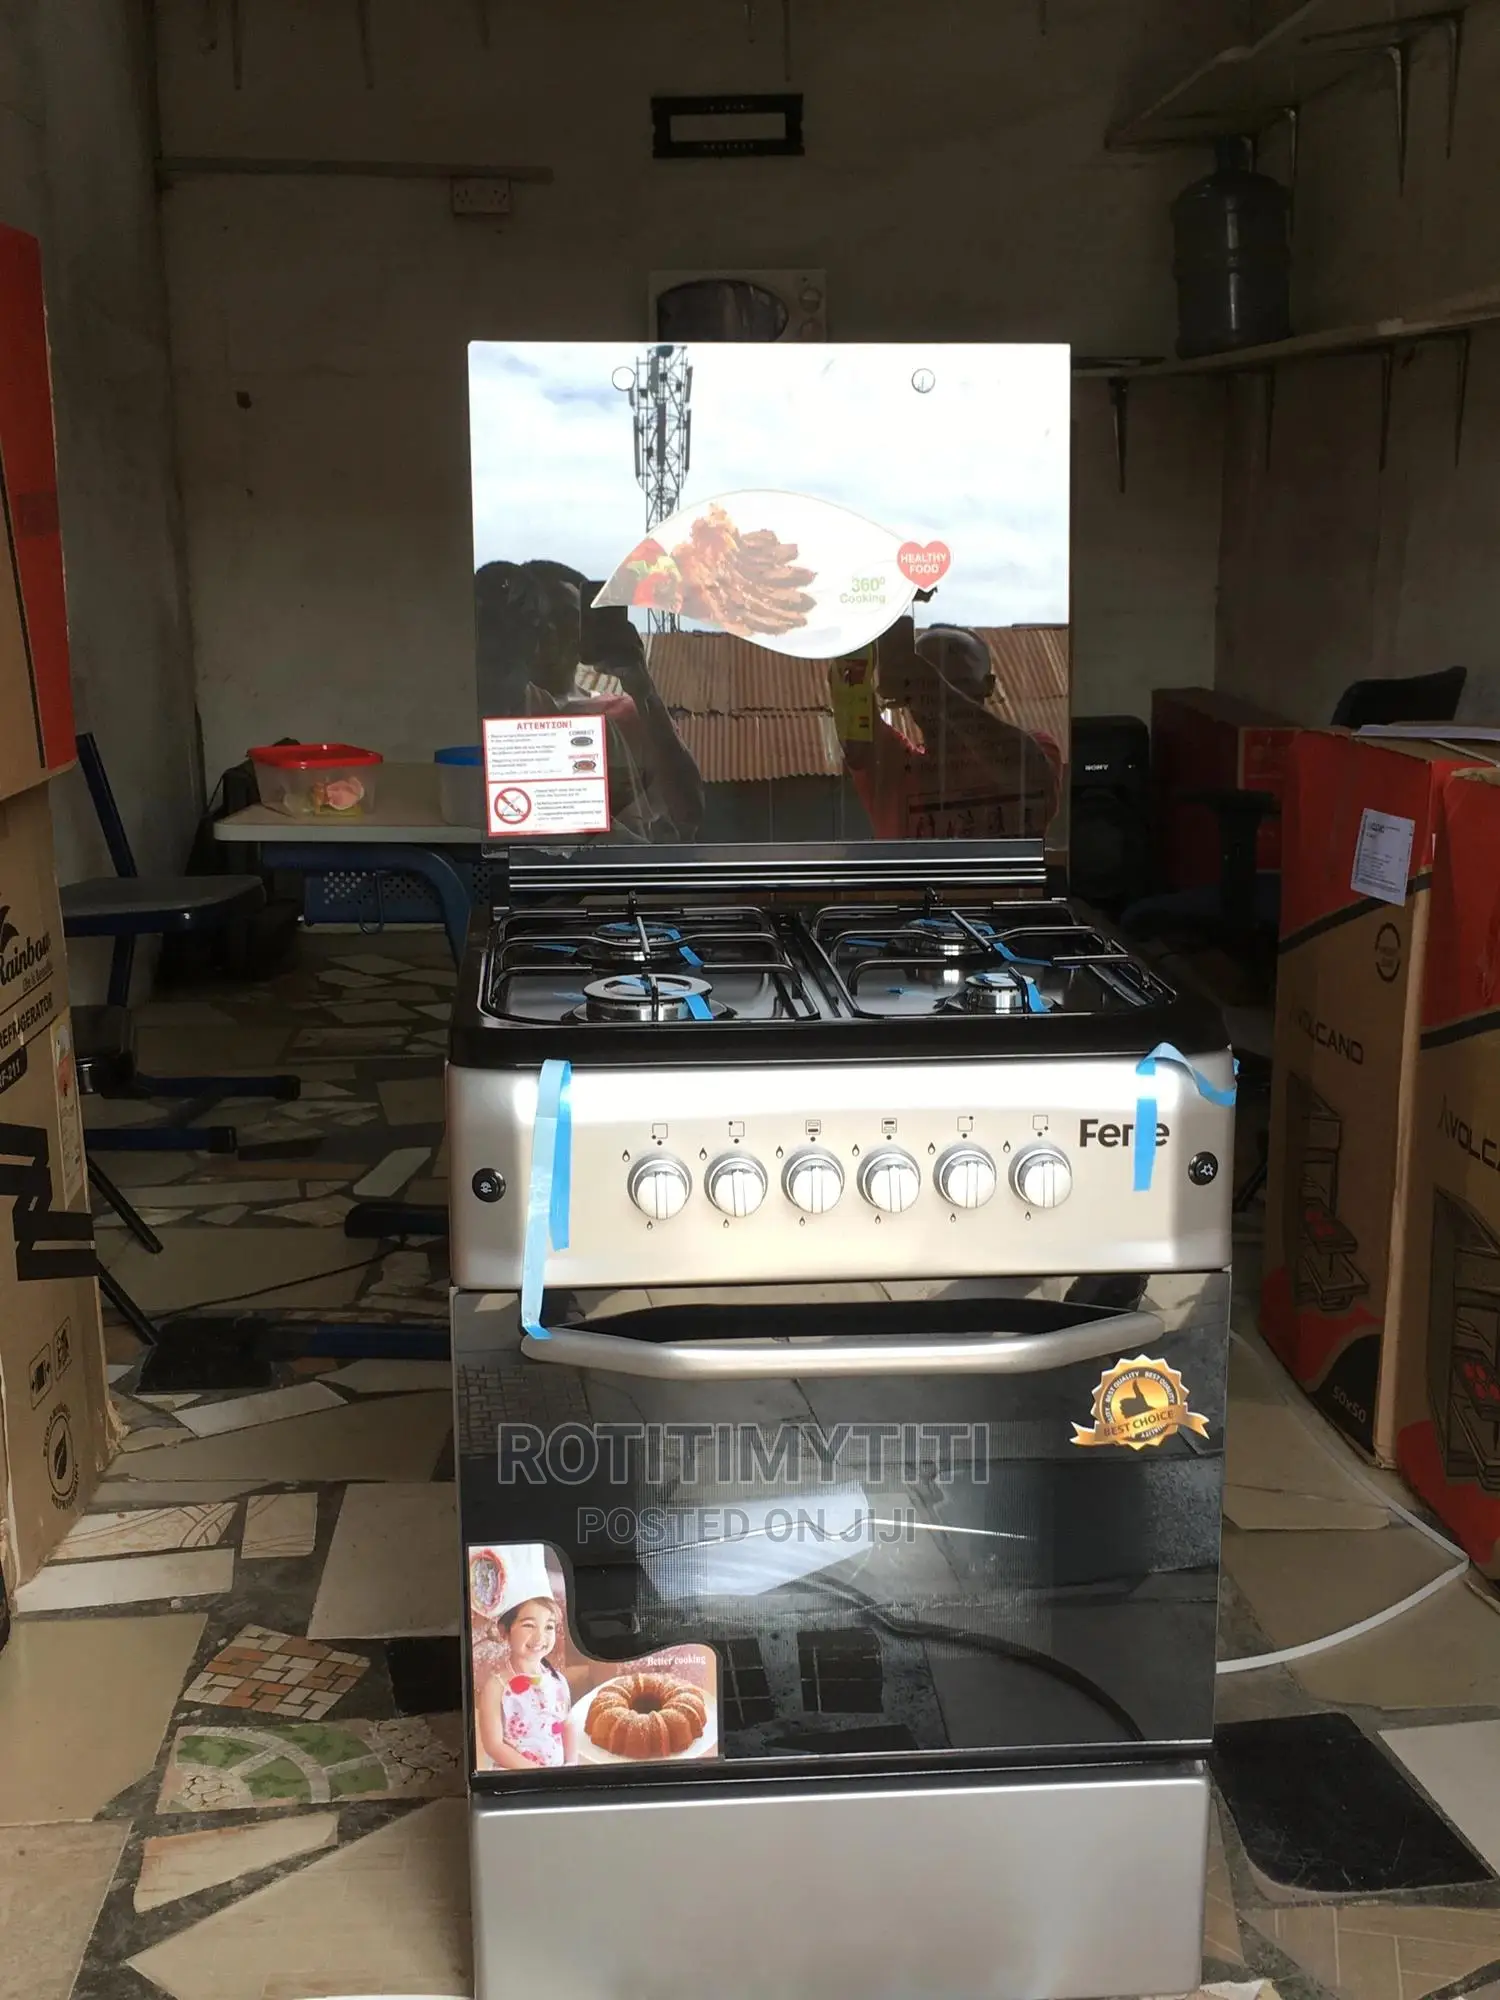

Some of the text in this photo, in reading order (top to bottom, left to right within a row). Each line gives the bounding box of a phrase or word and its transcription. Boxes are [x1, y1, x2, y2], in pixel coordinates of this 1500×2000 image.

[900, 552, 947, 565] HEALTHY
[909, 564, 940, 575] FOOD
[839, 593, 886, 605] Cooking
[516, 720, 573, 731] ATTENTION!
[0, 1058, 21, 1090] F-211
[1079, 1118, 1170, 1148] Fere
[1447, 1106, 1500, 1172] VOLC
[1103, 1423, 1131, 1437] BEST
[1132, 1410, 1175, 1429] CHOICE
[647, 1653, 707, 1666] Better cooking
